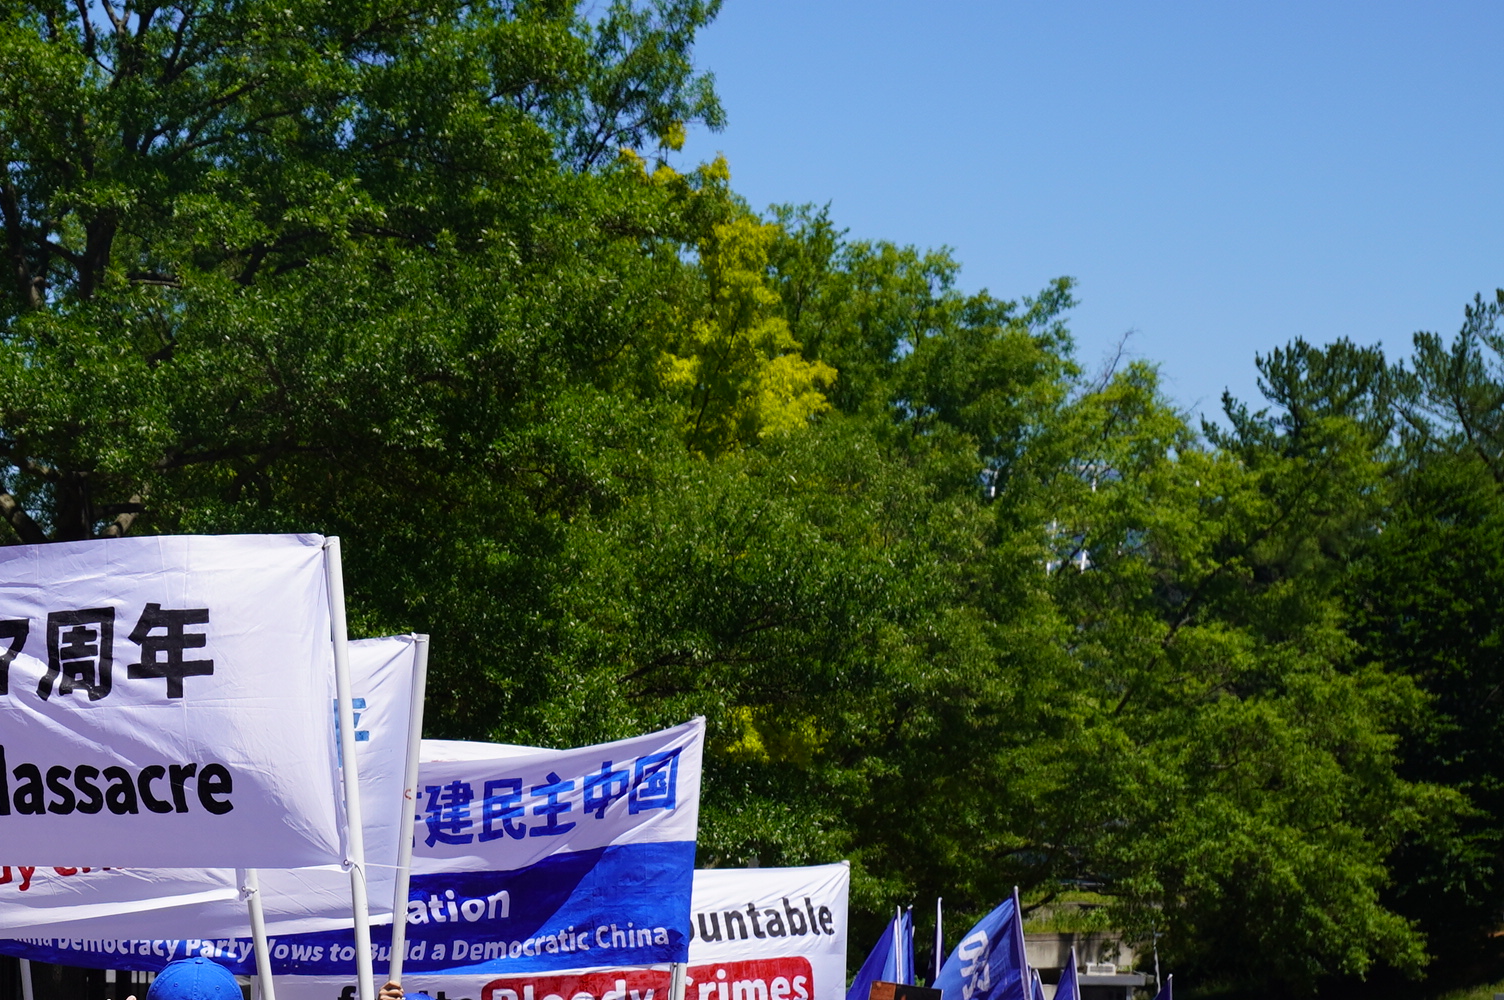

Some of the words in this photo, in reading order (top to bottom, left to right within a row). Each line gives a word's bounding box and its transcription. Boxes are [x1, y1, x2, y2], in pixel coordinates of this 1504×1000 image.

[414, 746, 683, 848] 建民主中国
[407, 889, 511, 925] ation
[57, 938, 180, 961] Democracy
[185, 938, 253, 963] Party
[329, 942, 355, 962] to
[370, 940, 427, 962] Buld
[431, 945, 445, 961] a
[451, 925, 589, 961] Democratic
[595, 922, 670, 950] China
